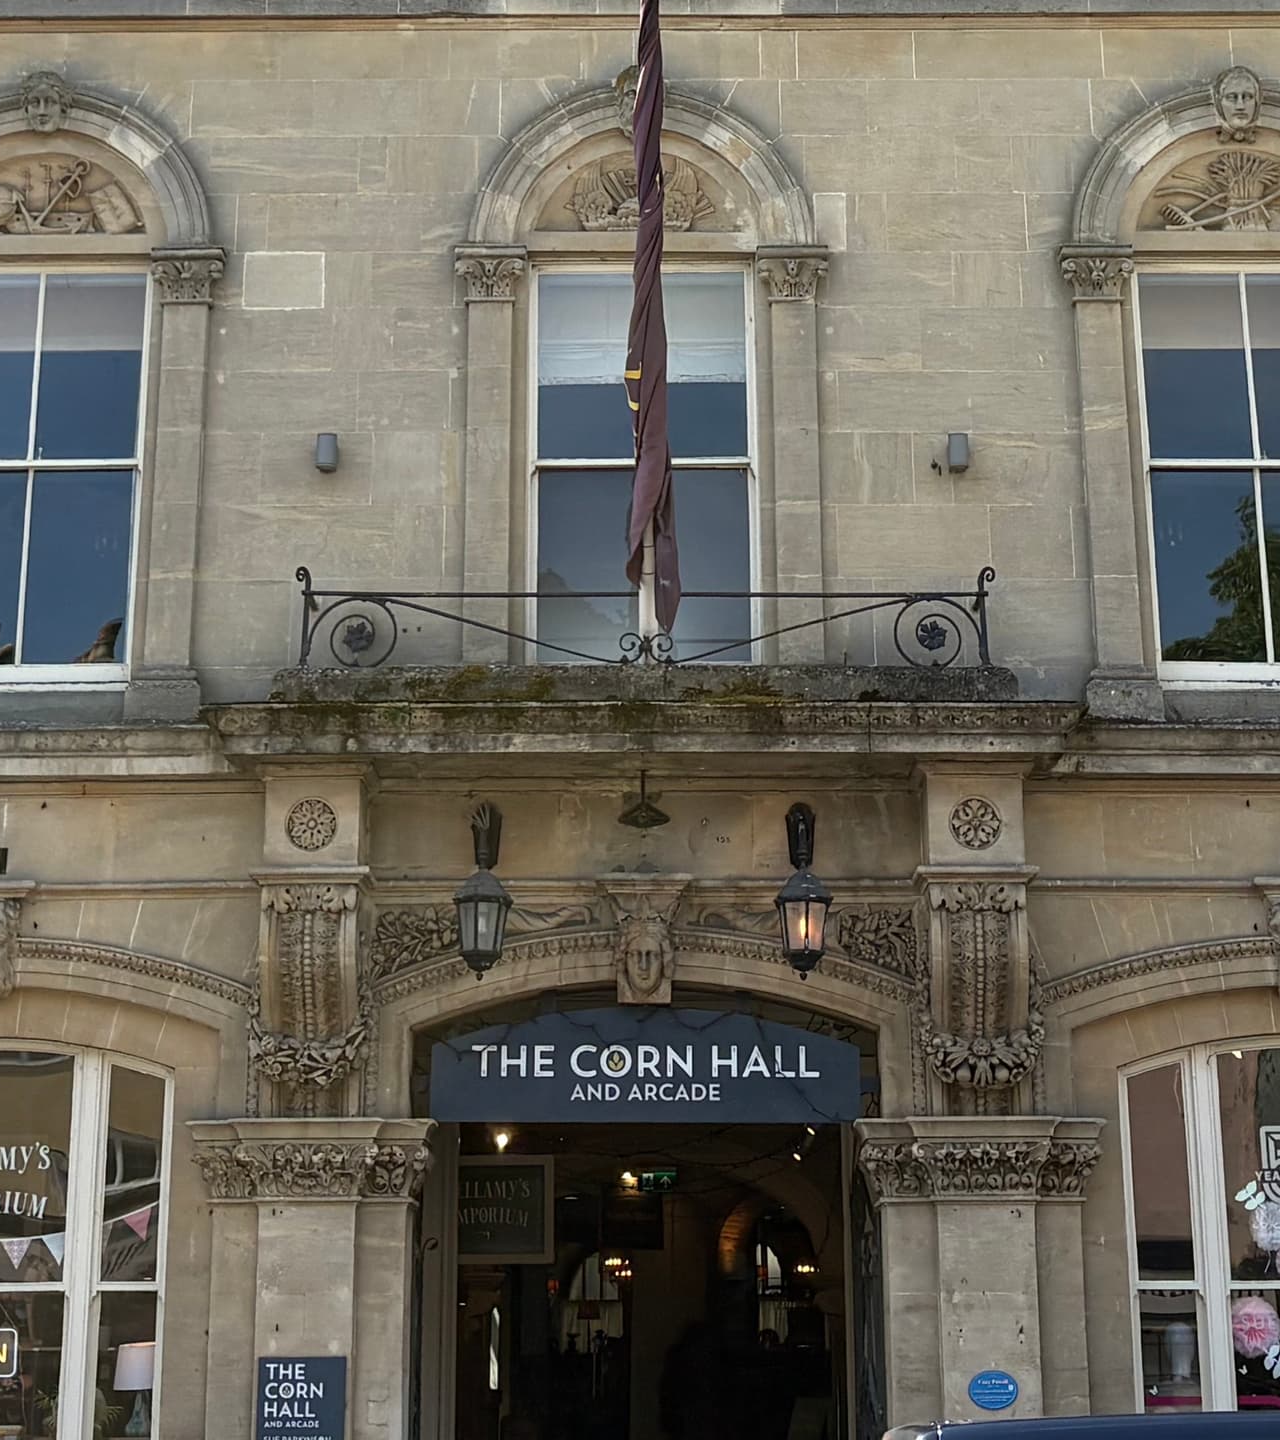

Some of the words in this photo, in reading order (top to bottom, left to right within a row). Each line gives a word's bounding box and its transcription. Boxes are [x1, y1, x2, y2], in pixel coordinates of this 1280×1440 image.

[471, 1045, 556, 1078] THE
[570, 1044, 693, 1078] CORN
[711, 1045, 821, 1078] HALL
[570, 1083, 620, 1101] AND
[627, 1083, 721, 1101] ARCADE
[458, 1207, 528, 1227] MPORIUM
[265, 1363, 306, 1380] THE
[265, 1382, 324, 1399] CORN
[263, 1401, 316, 1418] HALL
[263, 1420, 283, 1428] AND
[285, 1420, 320, 1428] ARCADE
